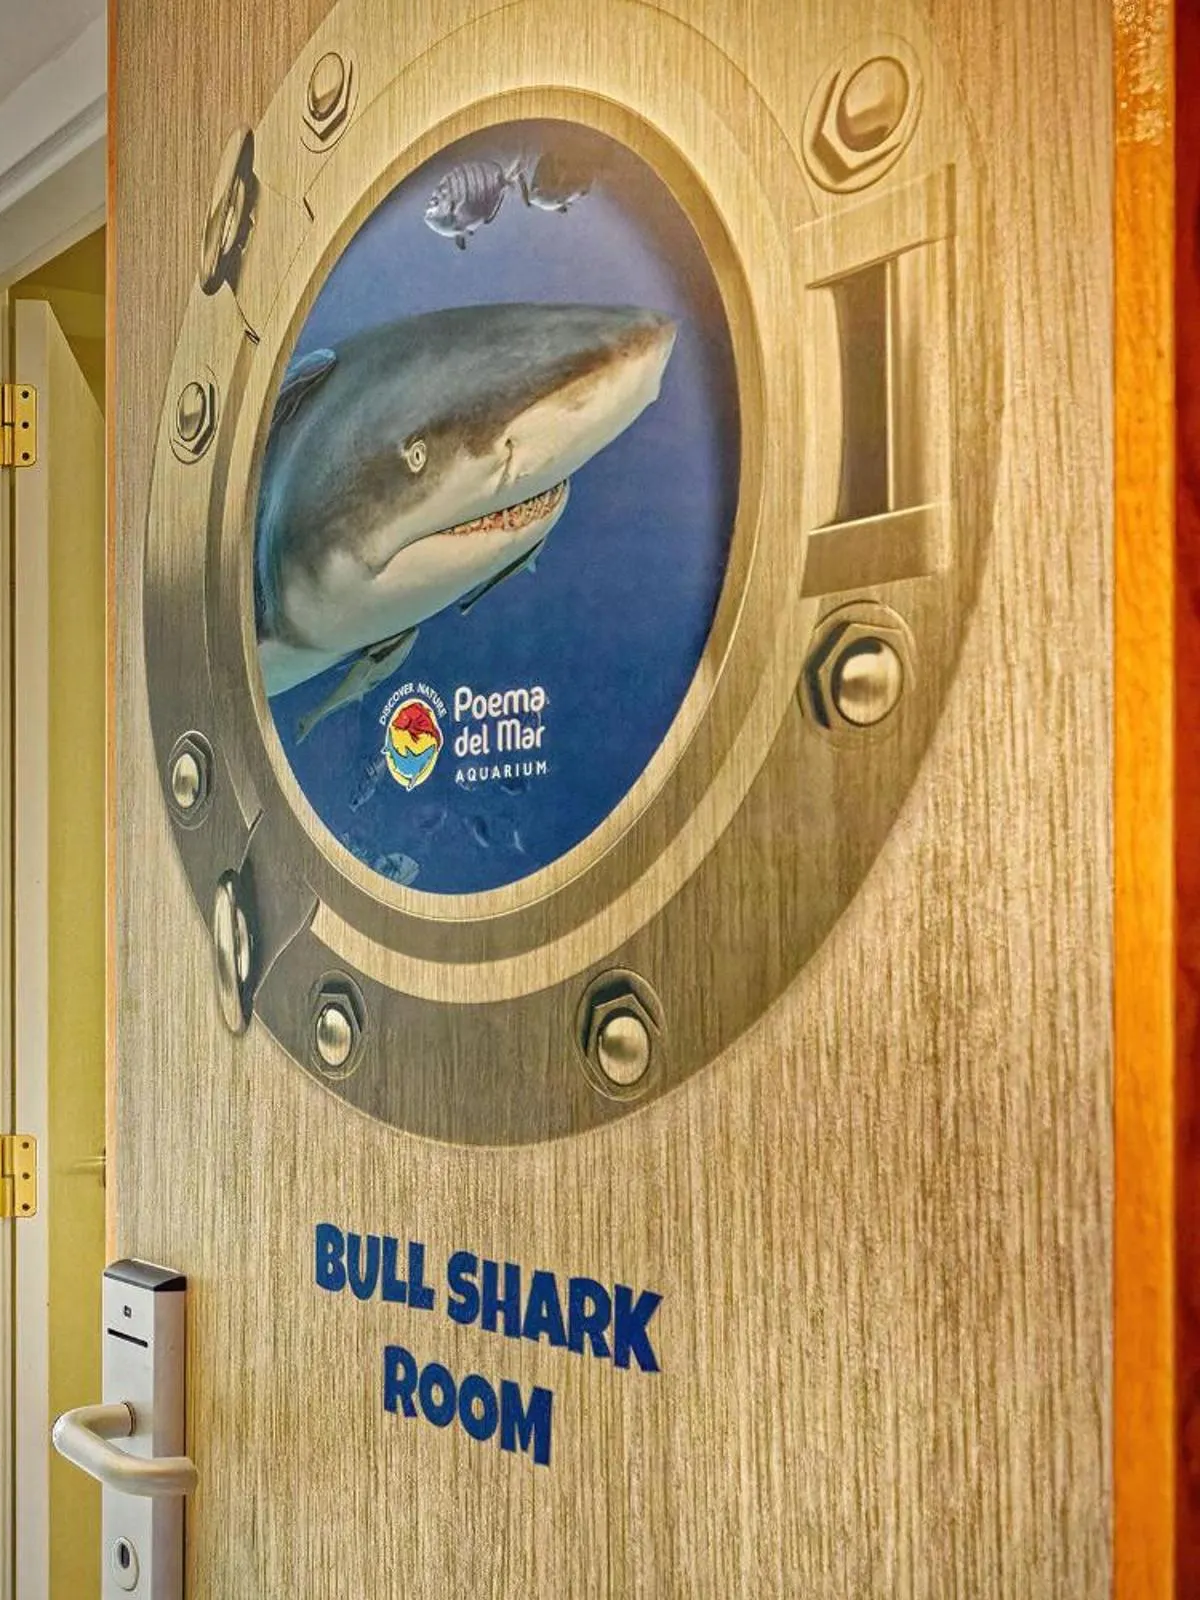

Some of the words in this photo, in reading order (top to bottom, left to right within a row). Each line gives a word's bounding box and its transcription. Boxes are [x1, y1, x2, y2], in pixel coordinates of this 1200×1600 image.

[379, 683, 414, 725] DISCOVER
[417, 682, 448, 718] NATURE
[453, 686, 545, 722] Poema
[454, 725, 490, 758] del
[497, 719, 546, 752] Mar
[454, 760, 548, 784] AQUARIUM
[315, 1223, 435, 1311] BULL
[446, 1250, 664, 1373] SHARK
[383, 1344, 554, 1467] ROOM
